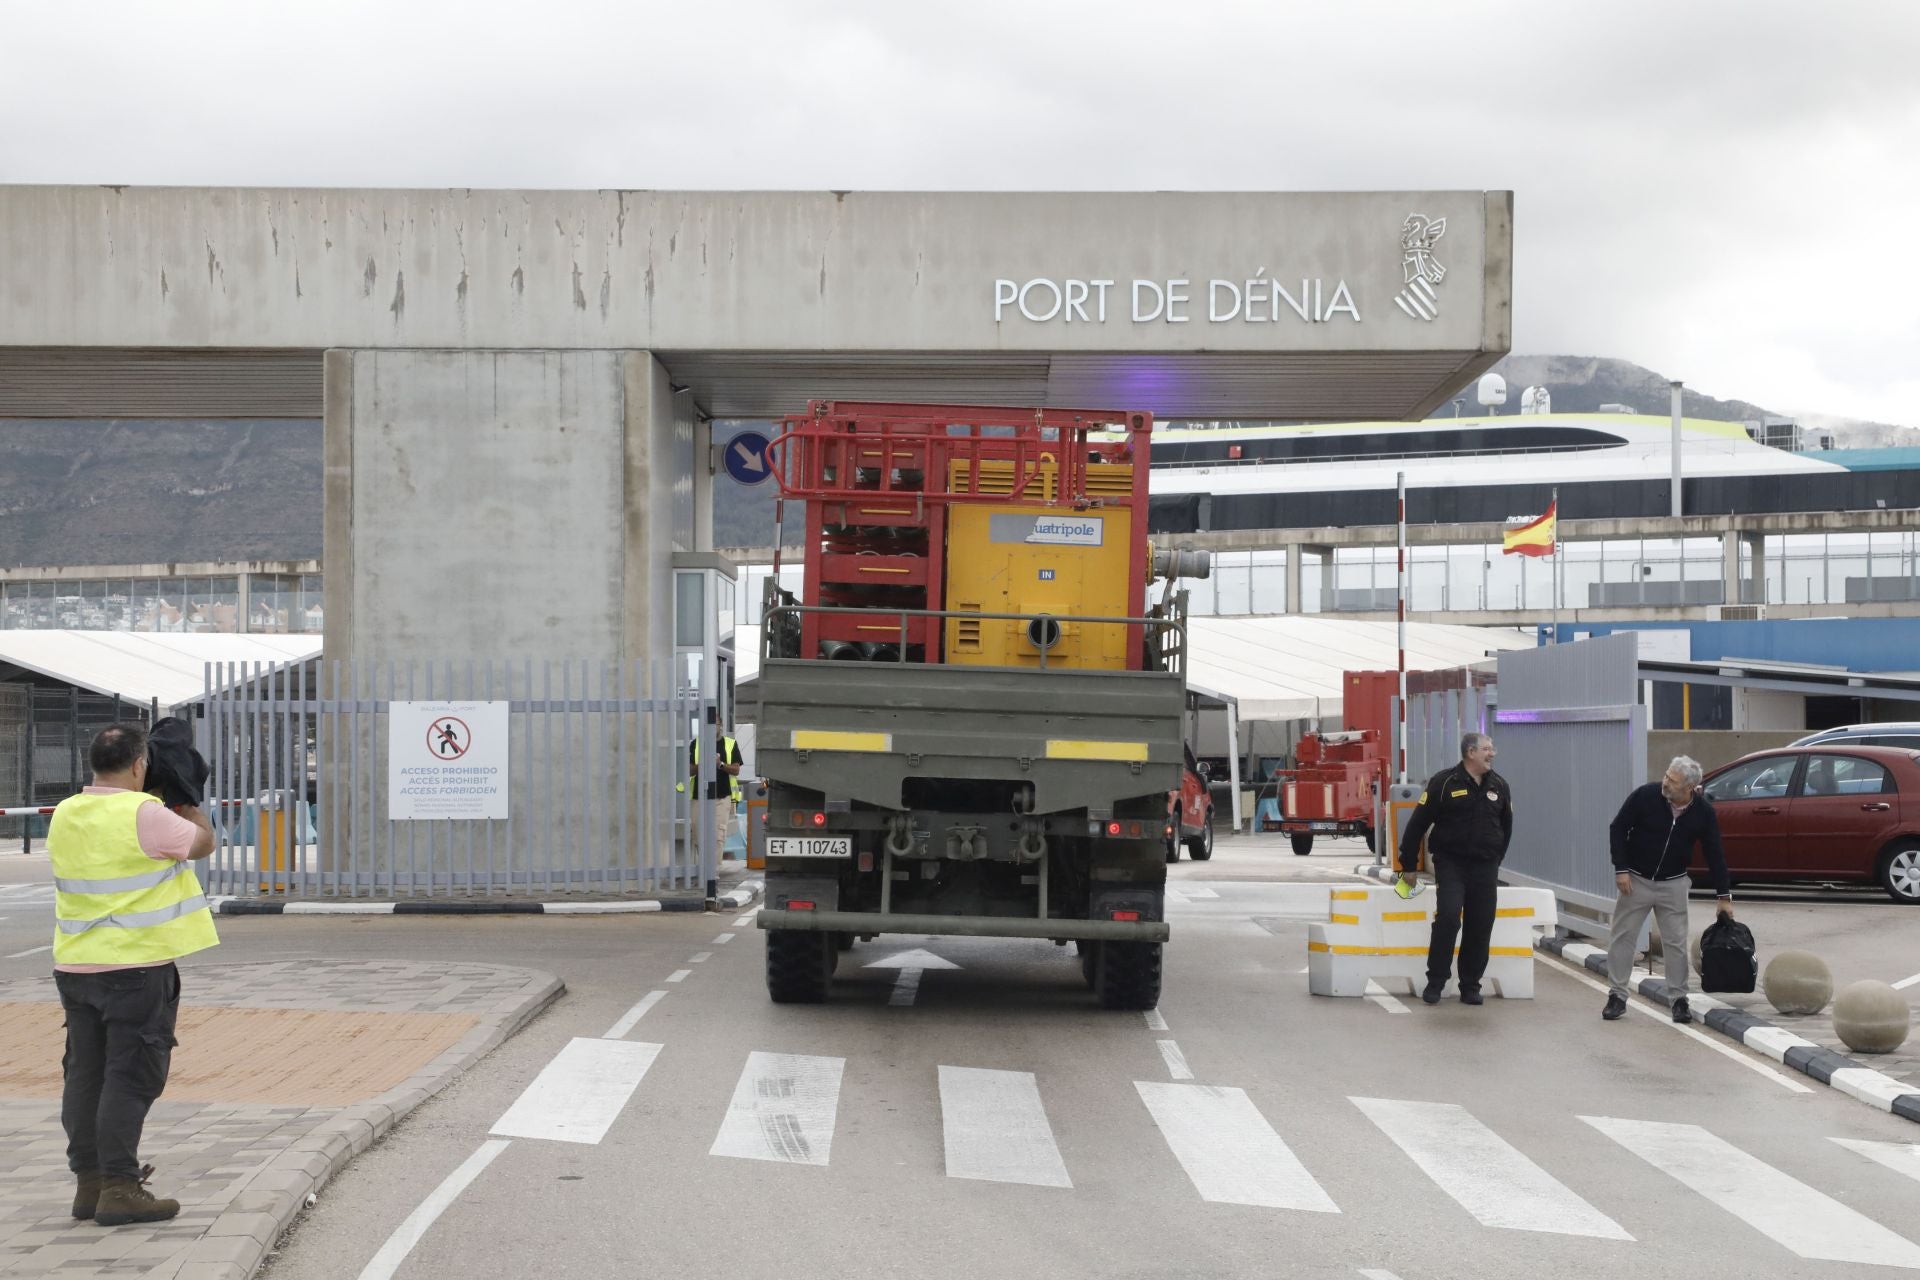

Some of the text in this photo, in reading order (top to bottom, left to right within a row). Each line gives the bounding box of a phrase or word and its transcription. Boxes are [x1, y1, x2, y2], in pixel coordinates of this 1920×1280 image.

[995, 266, 1361, 322] PORT DE DÉNIA
[1042, 571, 1052, 579] IN
[400, 767, 498, 775] ACCESO PROHIBIDO
[442, 777, 489, 785] PROHIBIT
[400, 787, 498, 795] ACCESS FORBIDDEN
